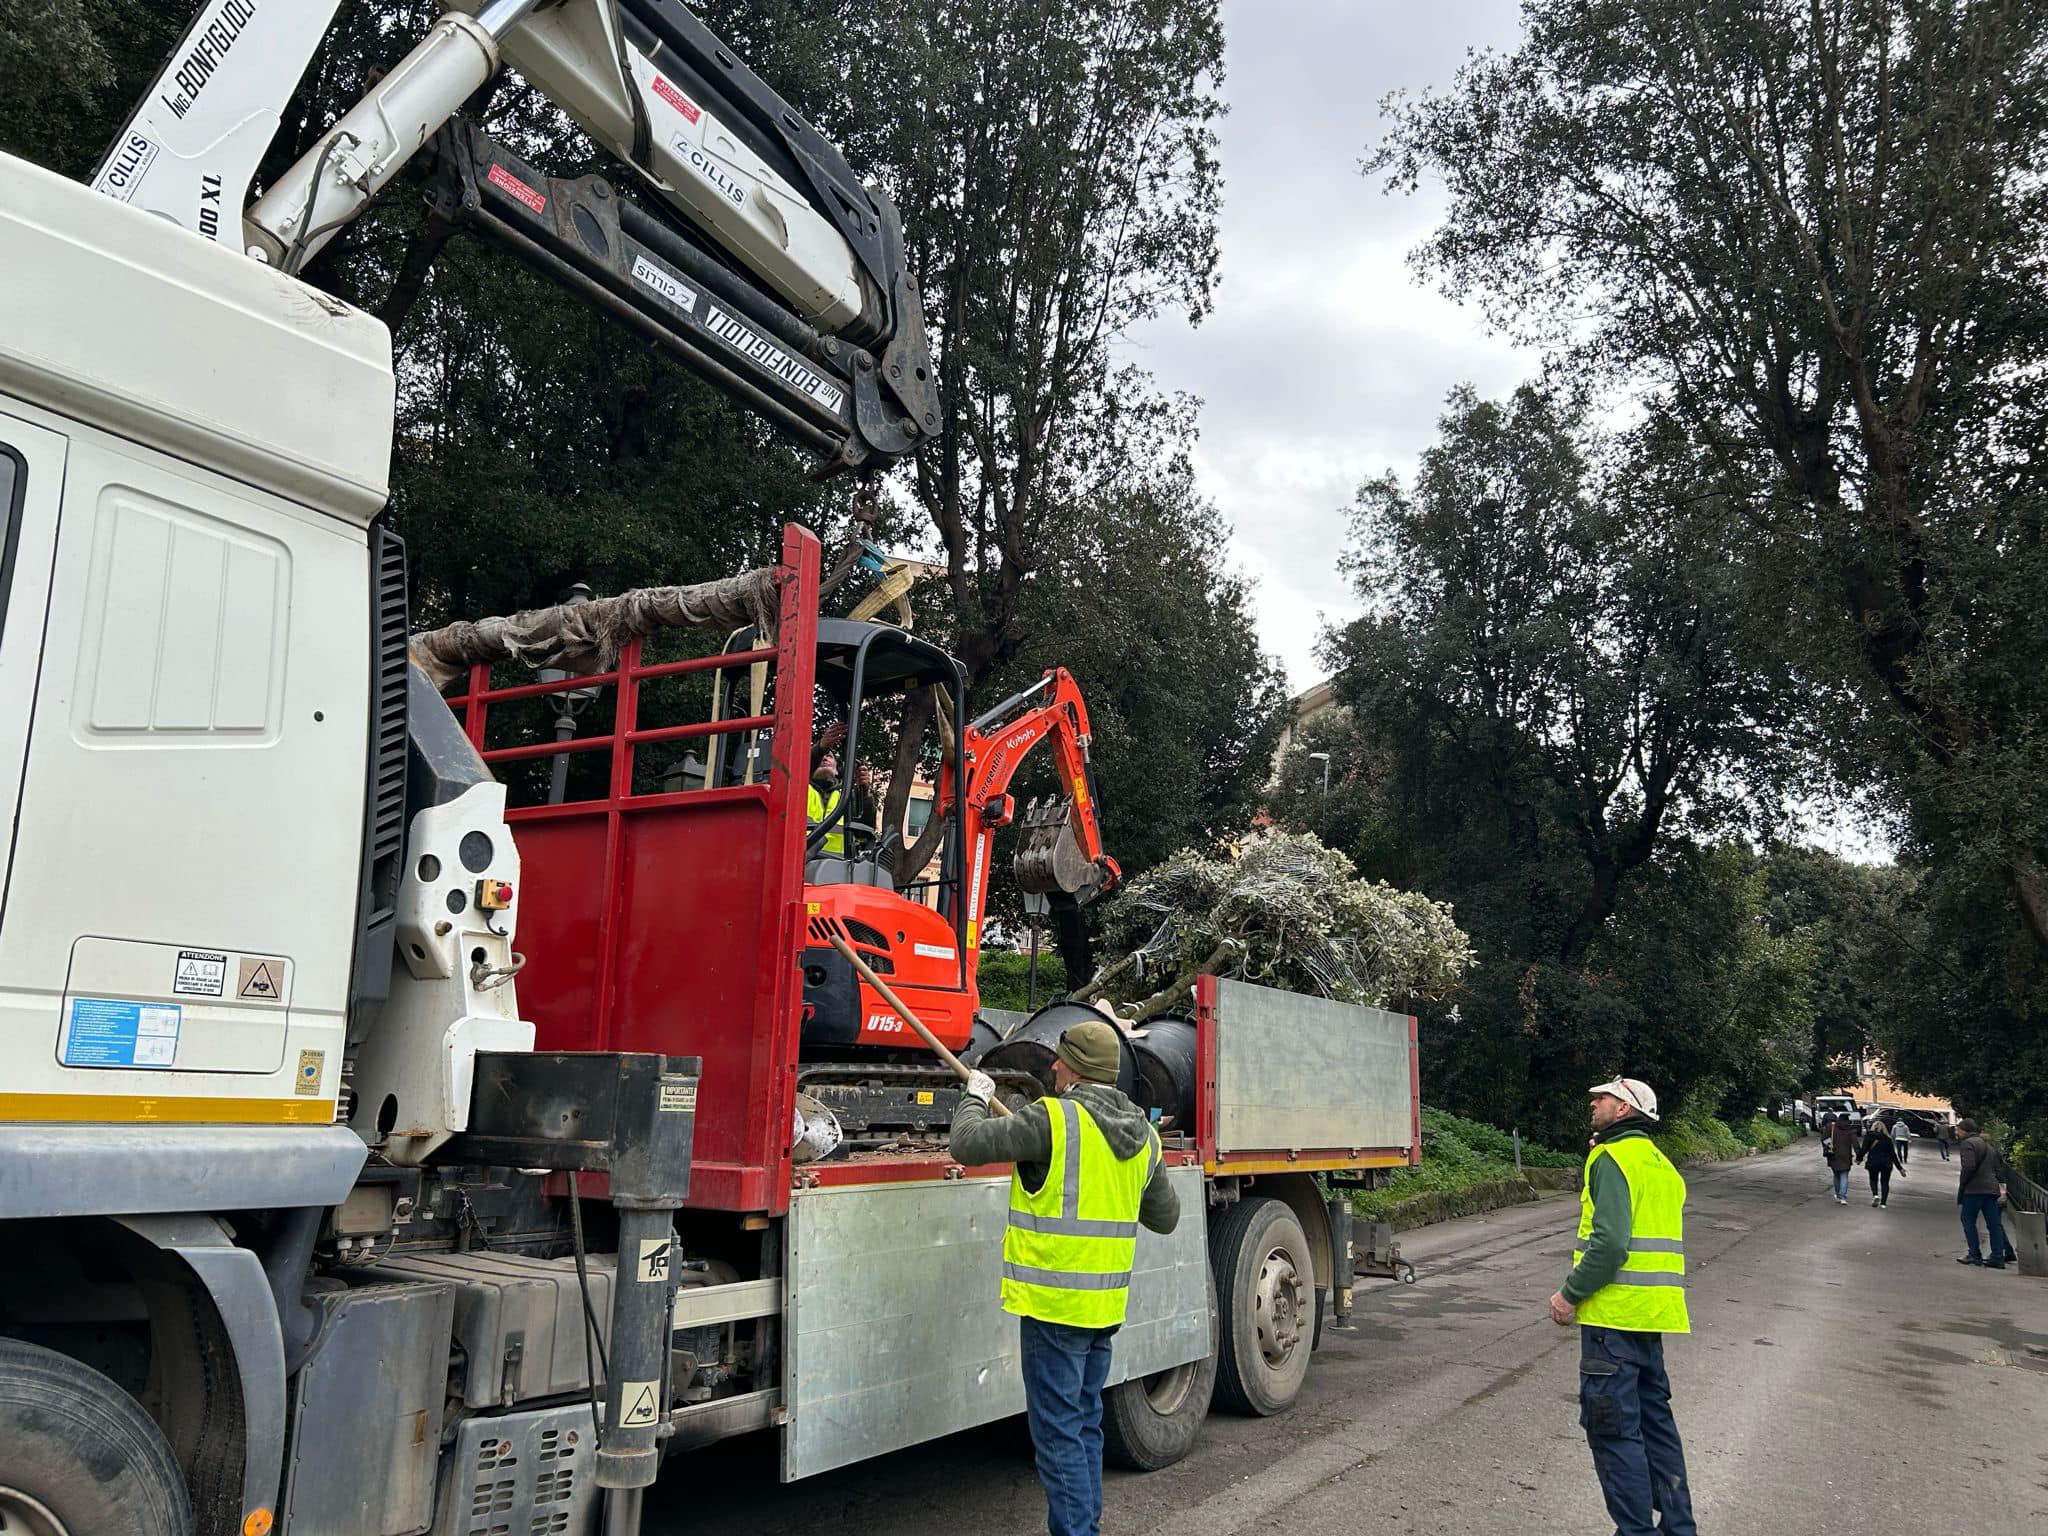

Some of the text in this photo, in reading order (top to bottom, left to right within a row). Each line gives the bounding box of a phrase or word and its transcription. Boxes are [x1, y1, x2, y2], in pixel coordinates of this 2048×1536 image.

[660, 82, 696, 114] ATTENZIONE
[108, 136, 148, 188] CILLIS
[691, 151, 744, 203] CILLIS
[201, 174, 222, 206] XL
[495, 177, 537, 208] ATTENZIONE
[636, 264, 677, 297] CILLIS
[706, 311, 823, 395] BONFIGLIOLI
[1005, 728, 1036, 749] Kubota
[976, 751, 1004, 803] Piergentili
[182, 952, 223, 961] ATTENZIONE
[867, 1015, 904, 1033] U15-3
